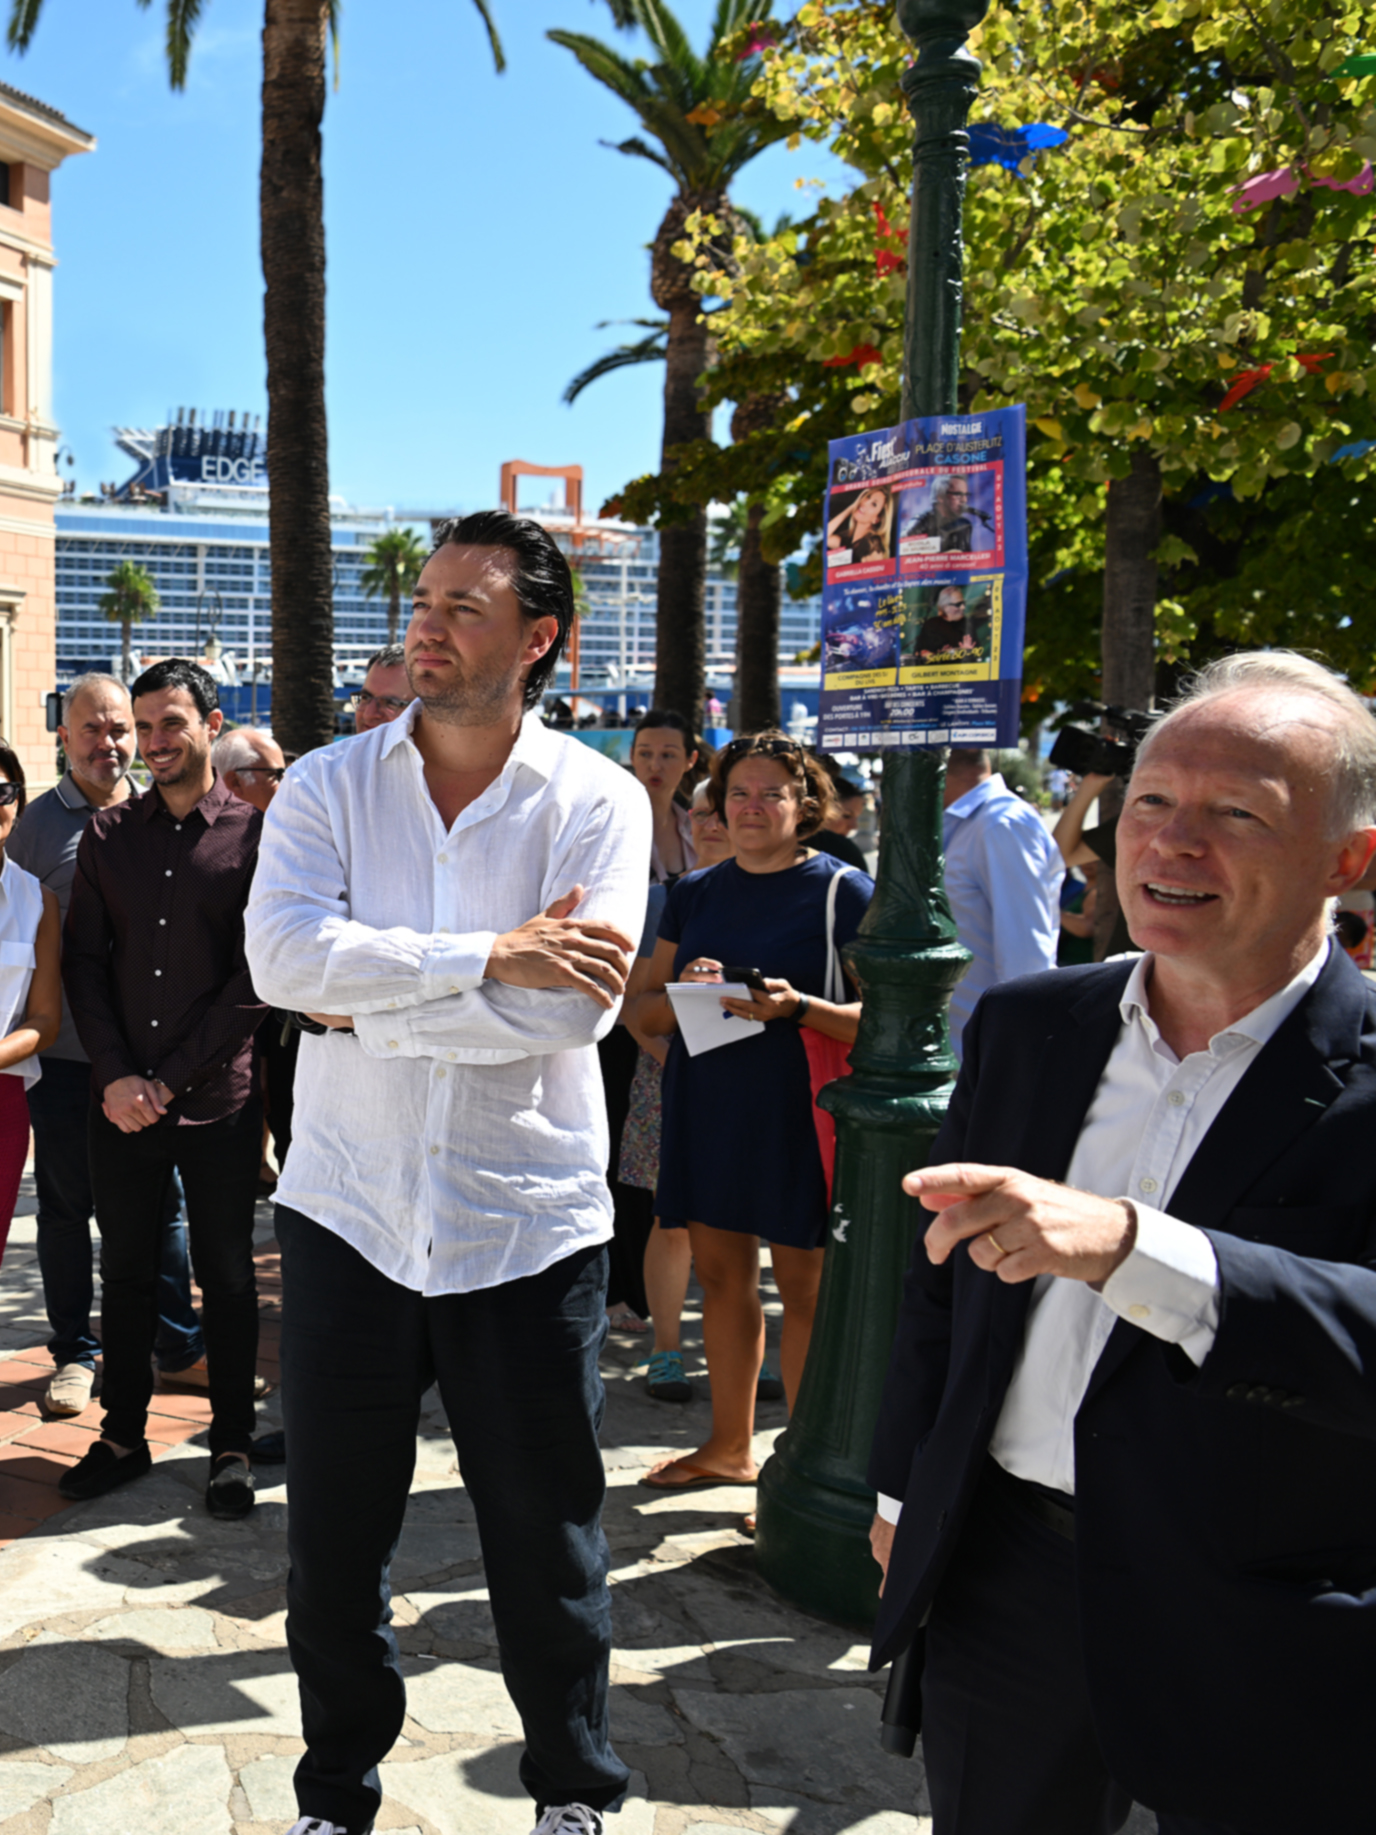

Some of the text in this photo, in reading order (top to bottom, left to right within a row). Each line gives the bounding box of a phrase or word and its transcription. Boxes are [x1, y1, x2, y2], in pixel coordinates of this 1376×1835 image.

[941, 422, 982, 436] NOSTALGIE
[915, 436, 1003, 454] PLACE D'AUSTERLITZ
[934, 452, 987, 465] CASONE
[202, 455, 264, 482] EDGE
[911, 669, 938, 679] GILBERT
